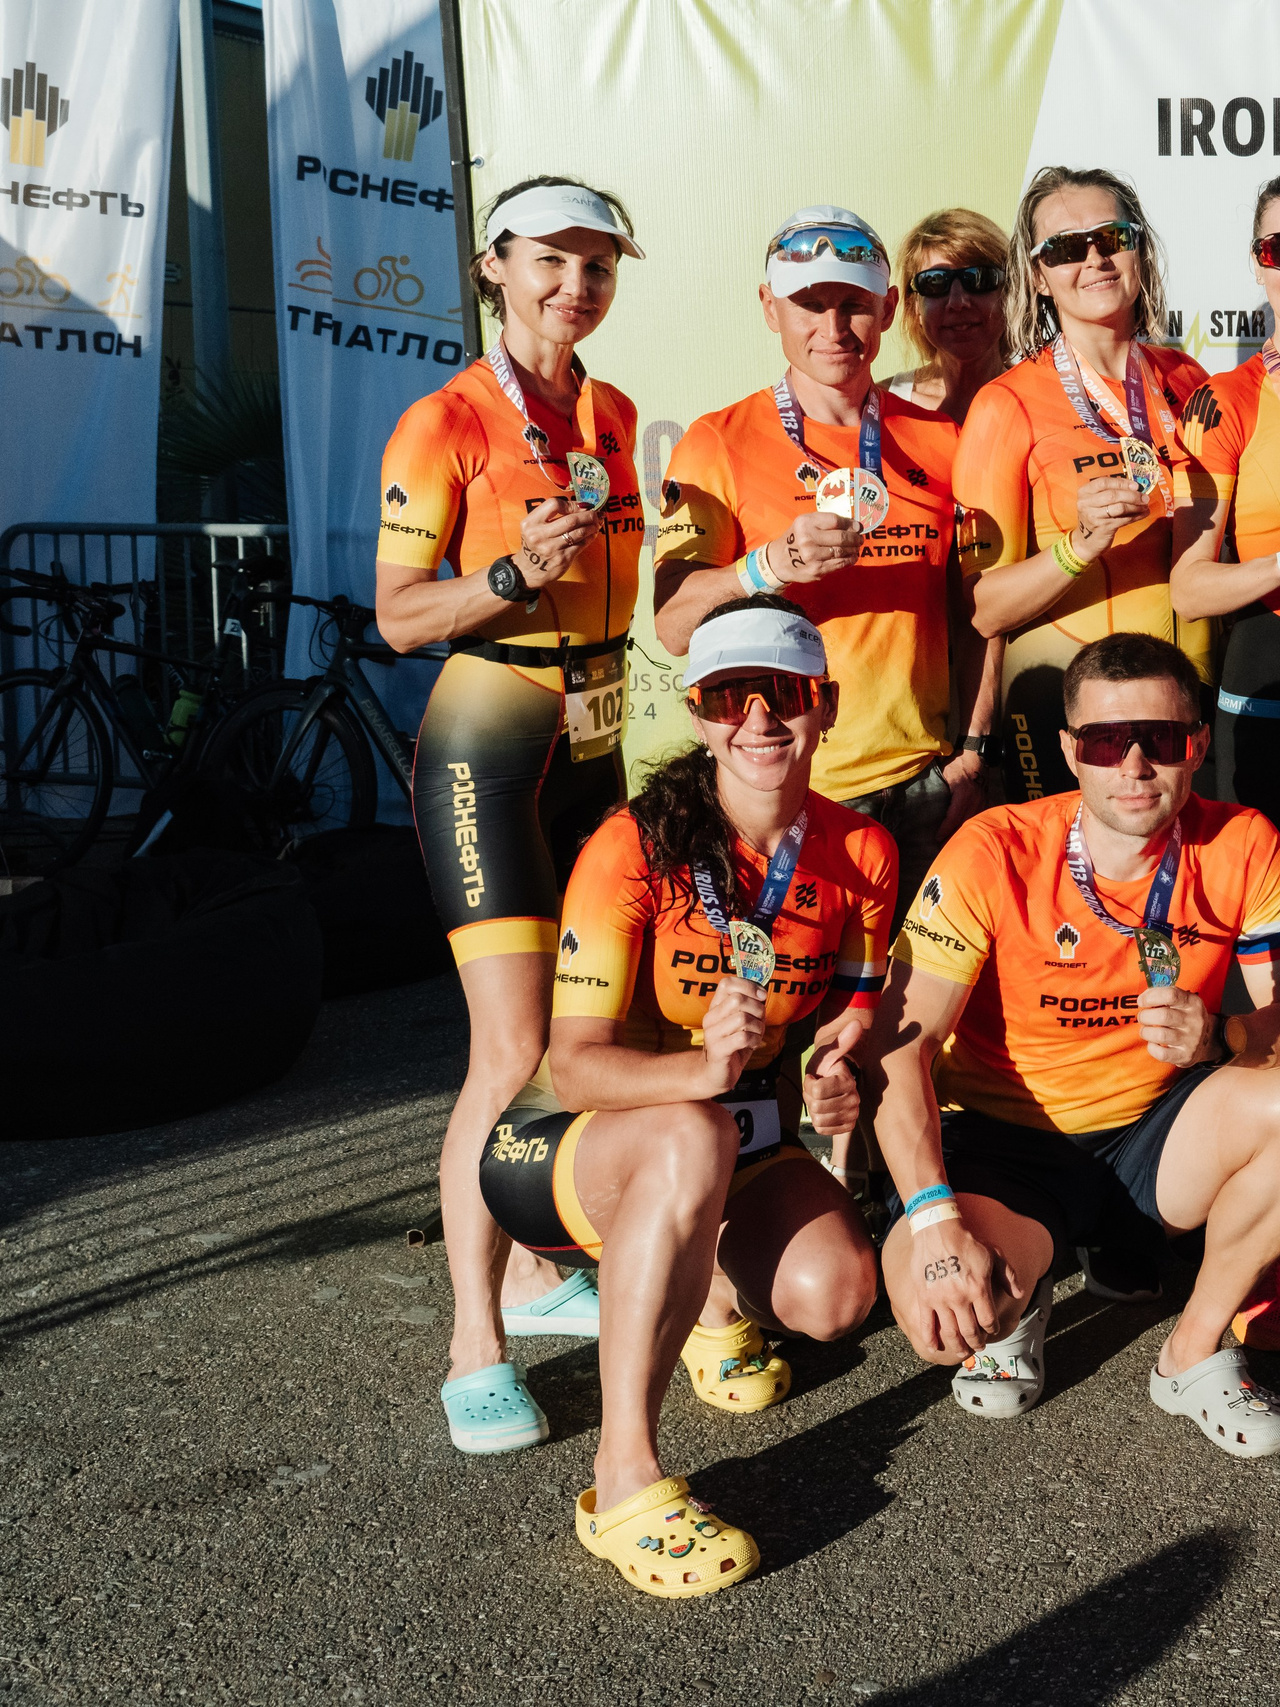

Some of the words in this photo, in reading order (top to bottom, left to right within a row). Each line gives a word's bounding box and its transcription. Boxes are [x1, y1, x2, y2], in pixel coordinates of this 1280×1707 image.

[1210, 309, 1266, 338] STAR
[1060, 374, 1079, 395] 1/8
[780, 410, 799, 431] 113
[860, 486, 877, 501] 113
[859, 544, 926, 558] АТЛОН
[361, 699, 413, 777] PINARELLO
[1010, 713, 1045, 801] РОСНЕ
[447, 762, 486, 908] РОСНЕФТЬ
[1067, 856, 1088, 882] 113
[1039, 993, 1140, 1013] РОСНЕ
[1056, 1014, 1138, 1029] ТРИАТ
[926, 1189, 942, 1199] 2024
[924, 1255, 962, 1283] 653
